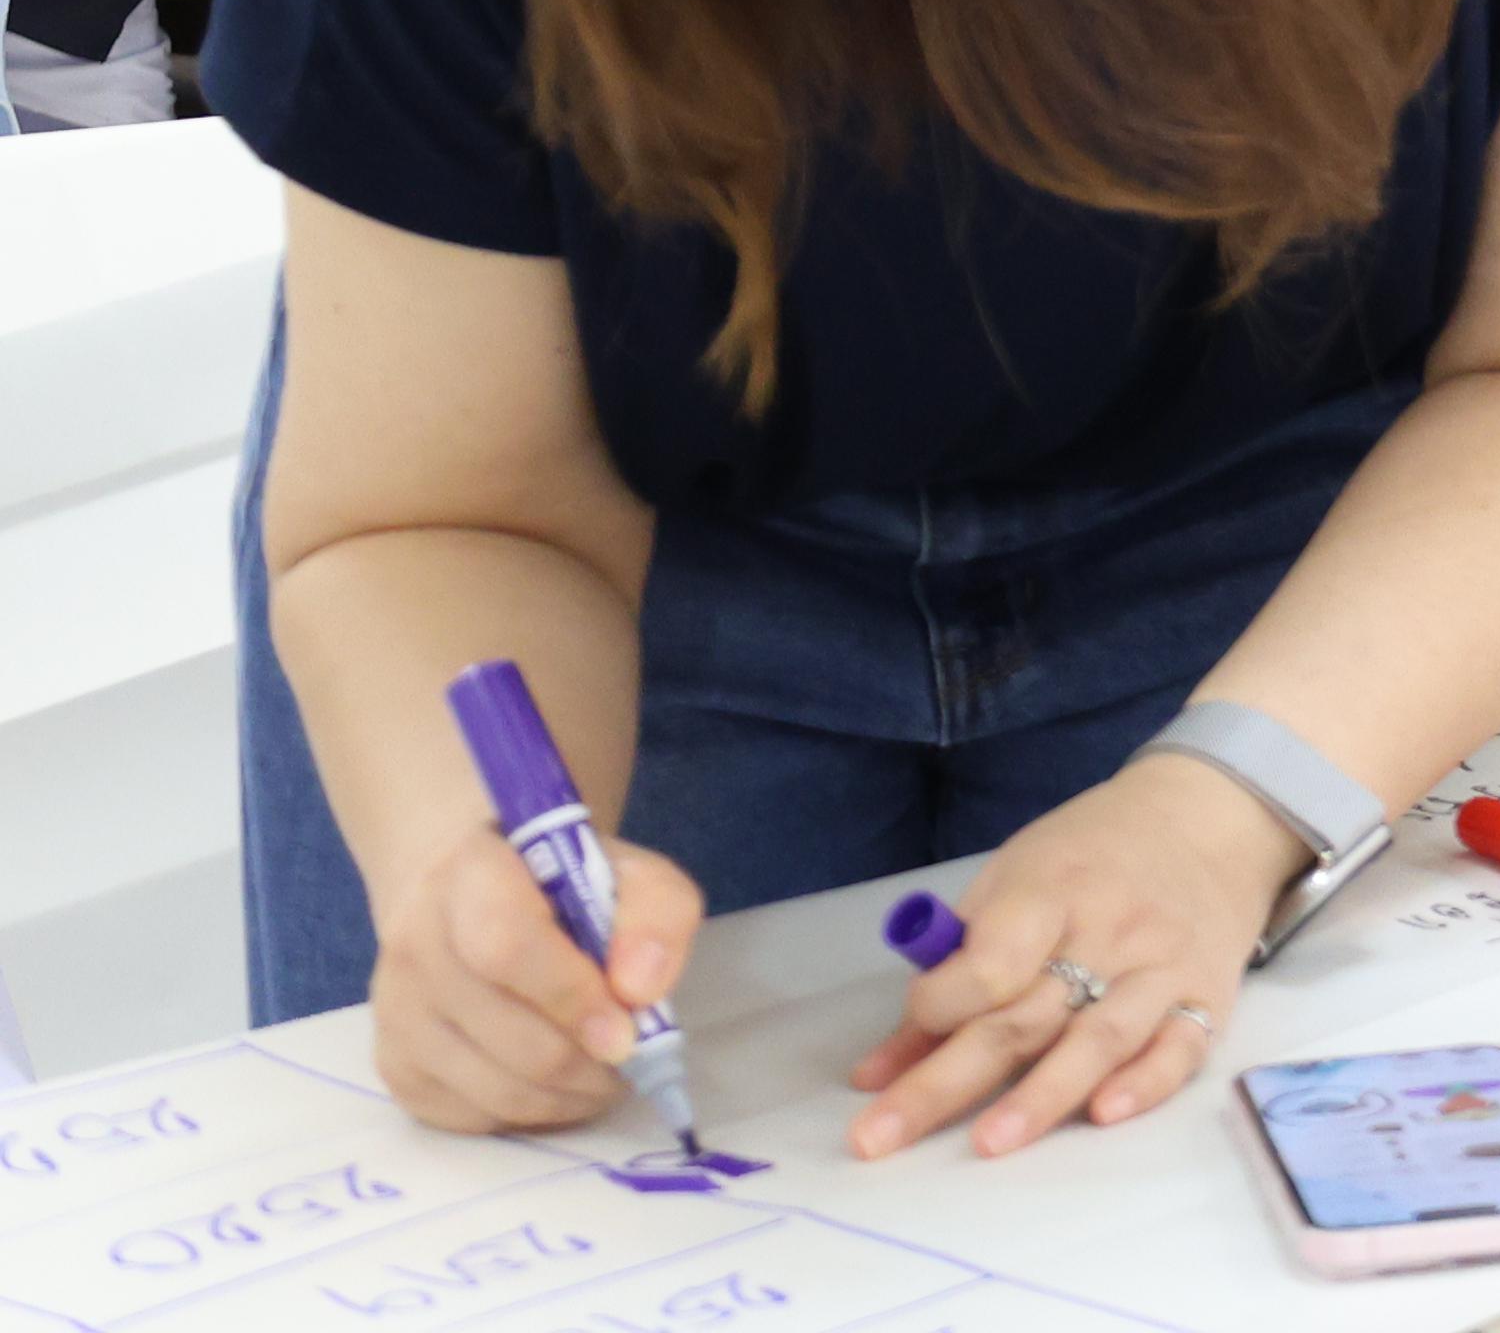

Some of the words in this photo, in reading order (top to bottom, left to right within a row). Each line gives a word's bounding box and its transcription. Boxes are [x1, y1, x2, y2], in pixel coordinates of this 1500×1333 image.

[0, 1095, 202, 1179] 252
[107, 1163, 403, 1274] 2520
[545, 1272, 790, 1333] 251
